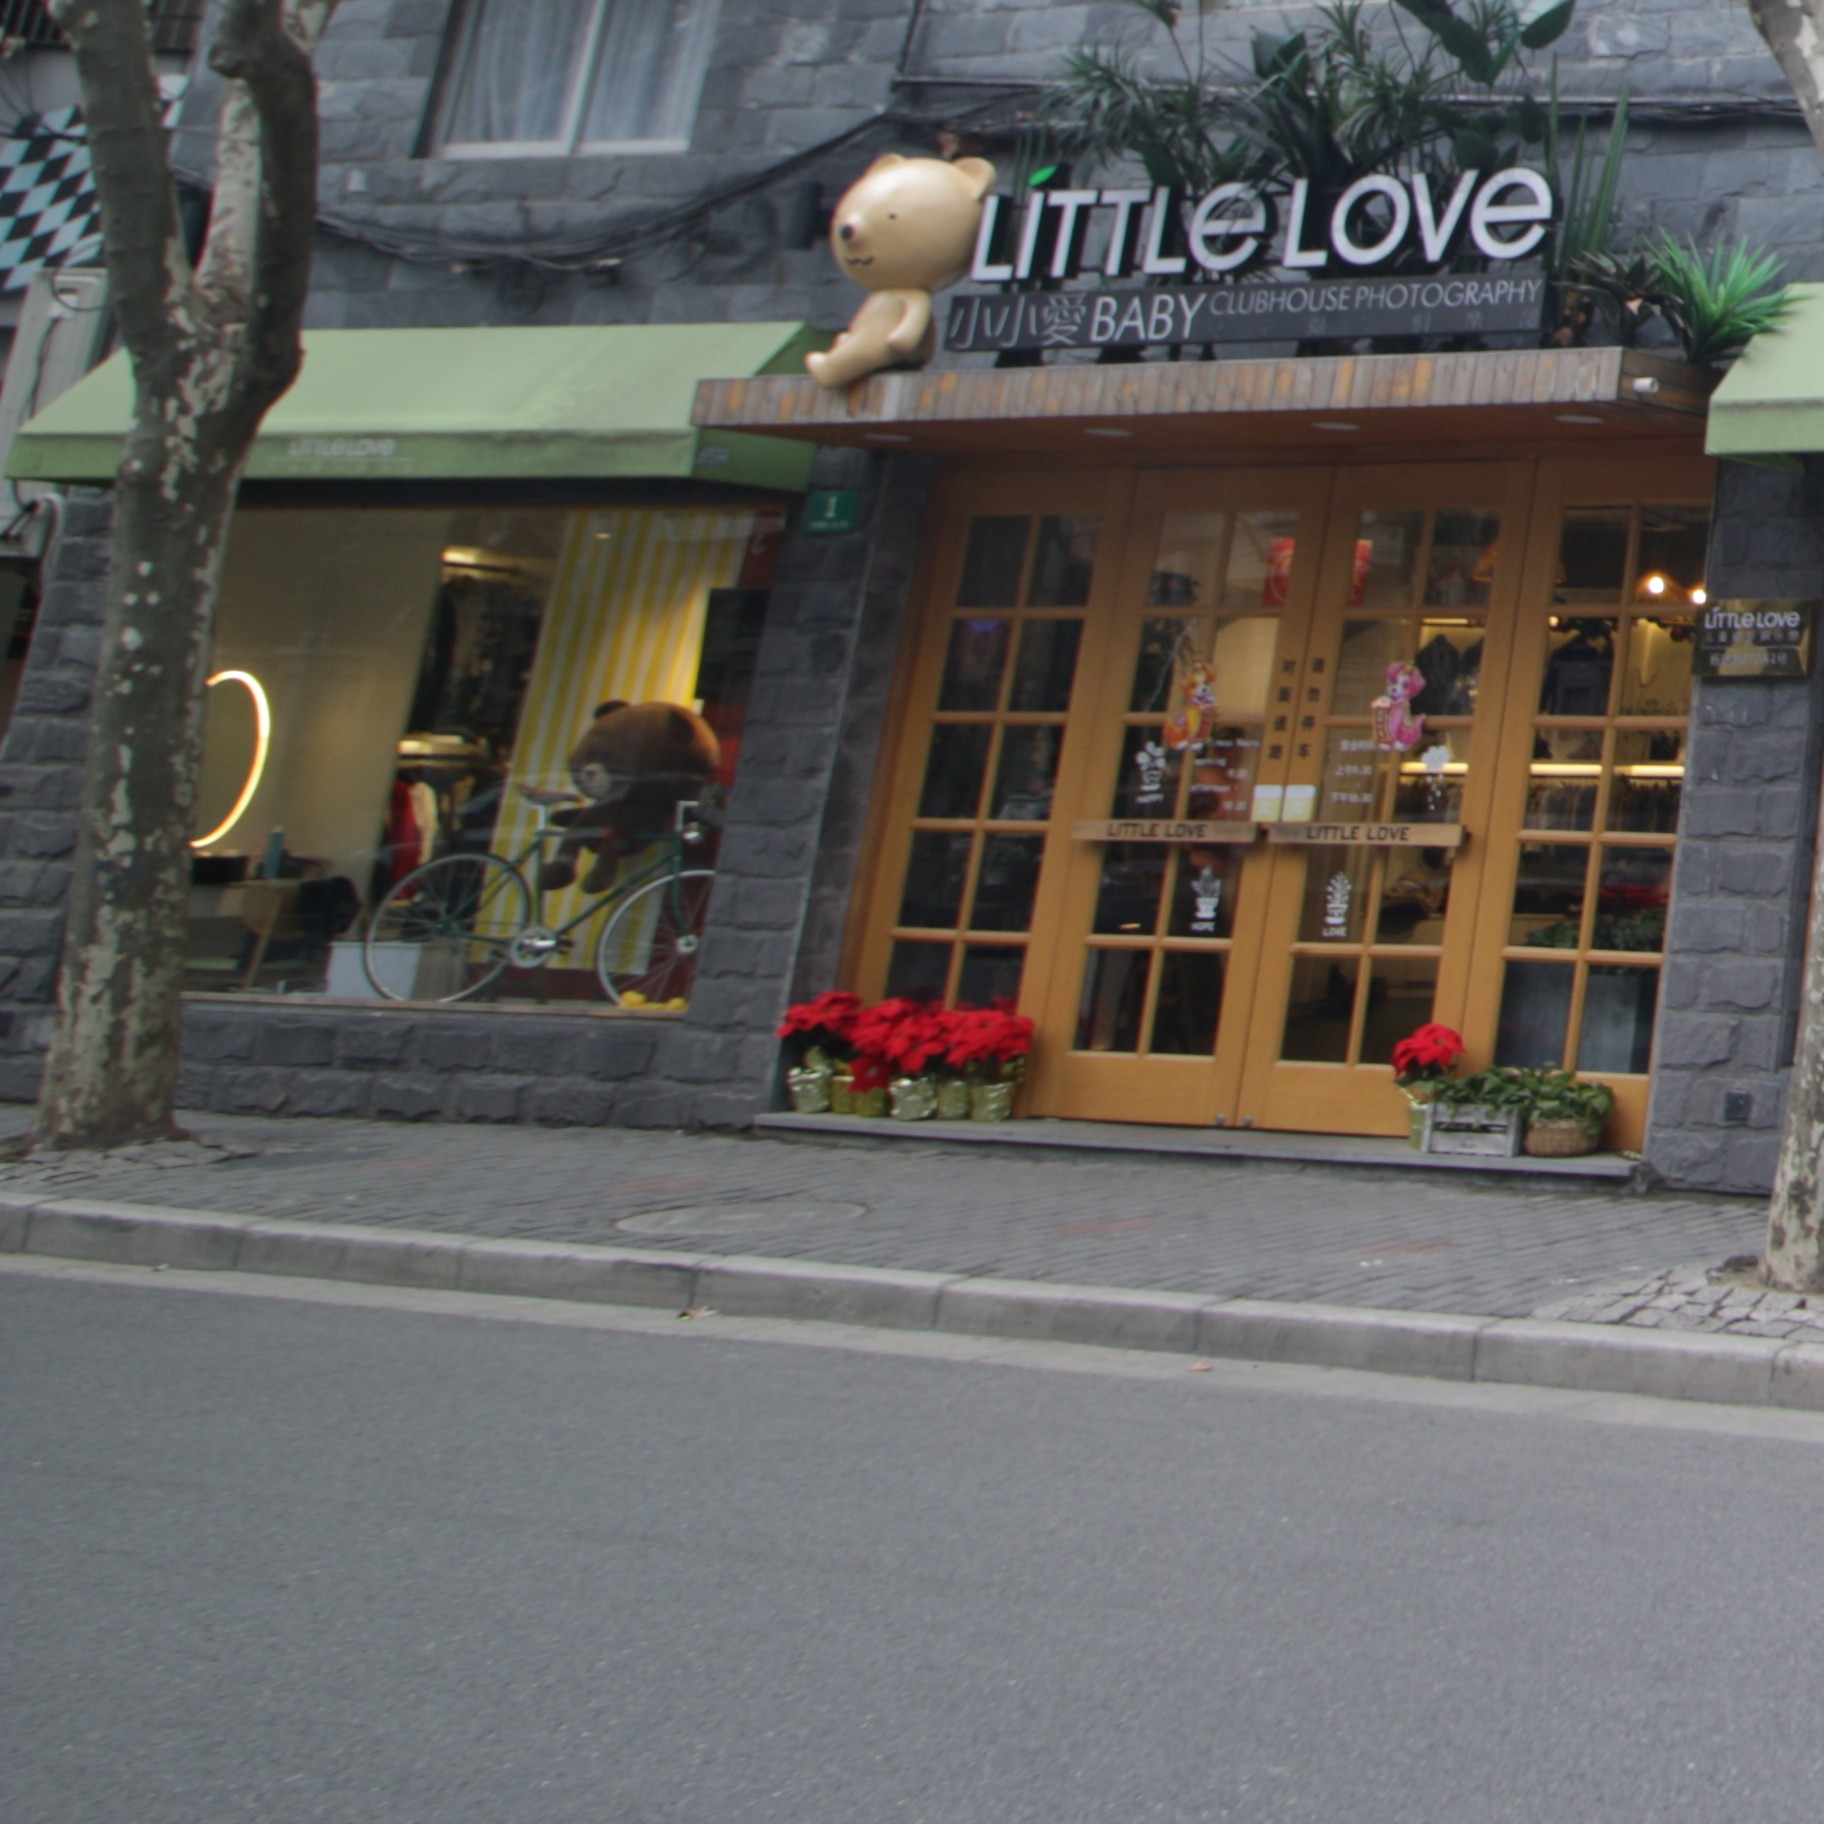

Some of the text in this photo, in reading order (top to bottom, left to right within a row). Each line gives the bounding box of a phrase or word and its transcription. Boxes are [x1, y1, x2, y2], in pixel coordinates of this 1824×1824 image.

[1208, 278, 1543, 316] CLUBHOUSE PHOTOGRAPHY
[1088, 293, 1208, 344] BABY
[1106, 823, 1206, 838] LITTLE LOVE
[1306, 825, 1411, 841] LITTLE LOVE
